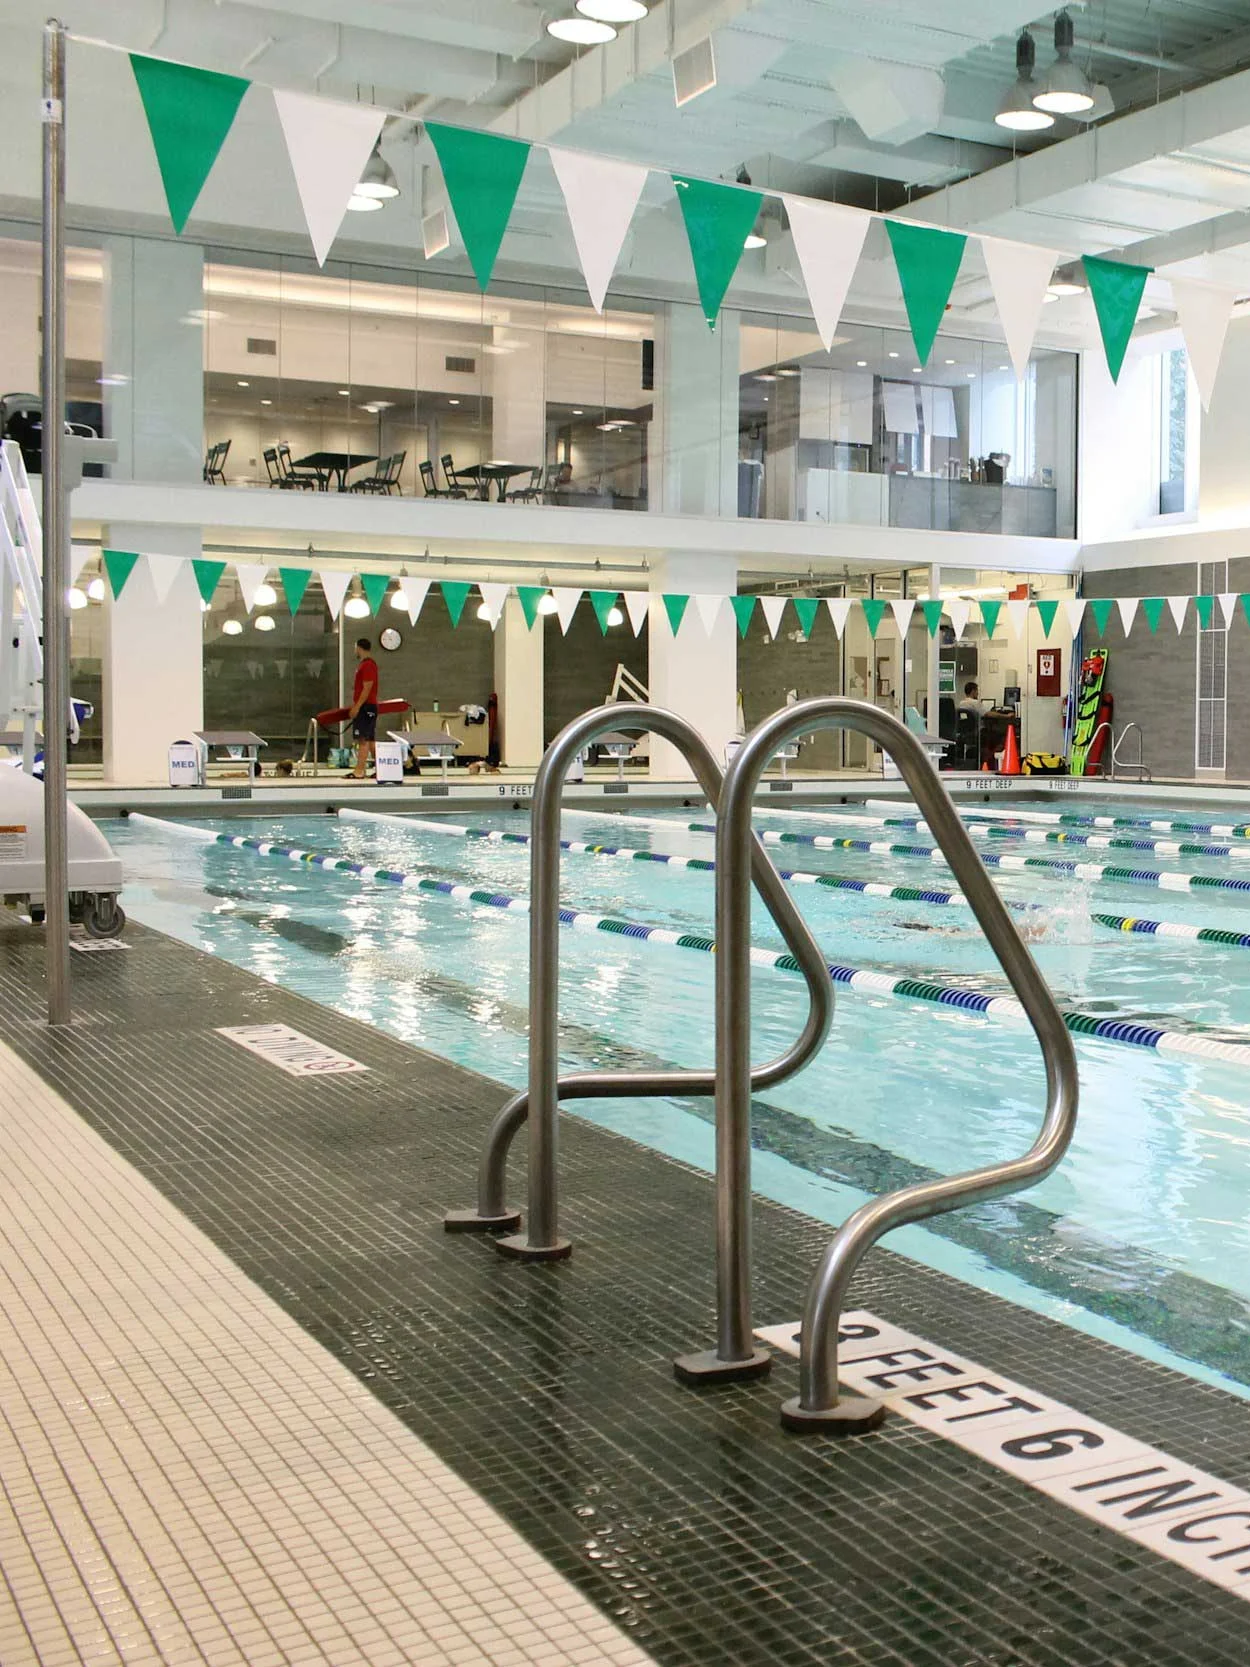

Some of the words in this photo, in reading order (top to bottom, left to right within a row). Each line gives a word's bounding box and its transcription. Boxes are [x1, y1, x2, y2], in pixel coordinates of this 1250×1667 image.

[171, 760, 195, 769] MED
[378, 757, 400, 765] MED
[966, 780, 972, 789] 9
[975, 780, 993, 789] FEET
[995, 780, 1013, 789] DEEP
[499, 786, 505, 796] 9
[511, 786, 532, 796] FEET
[838, 1347, 1045, 1423] FEET
[1000, 1427, 1105, 1460] 6
